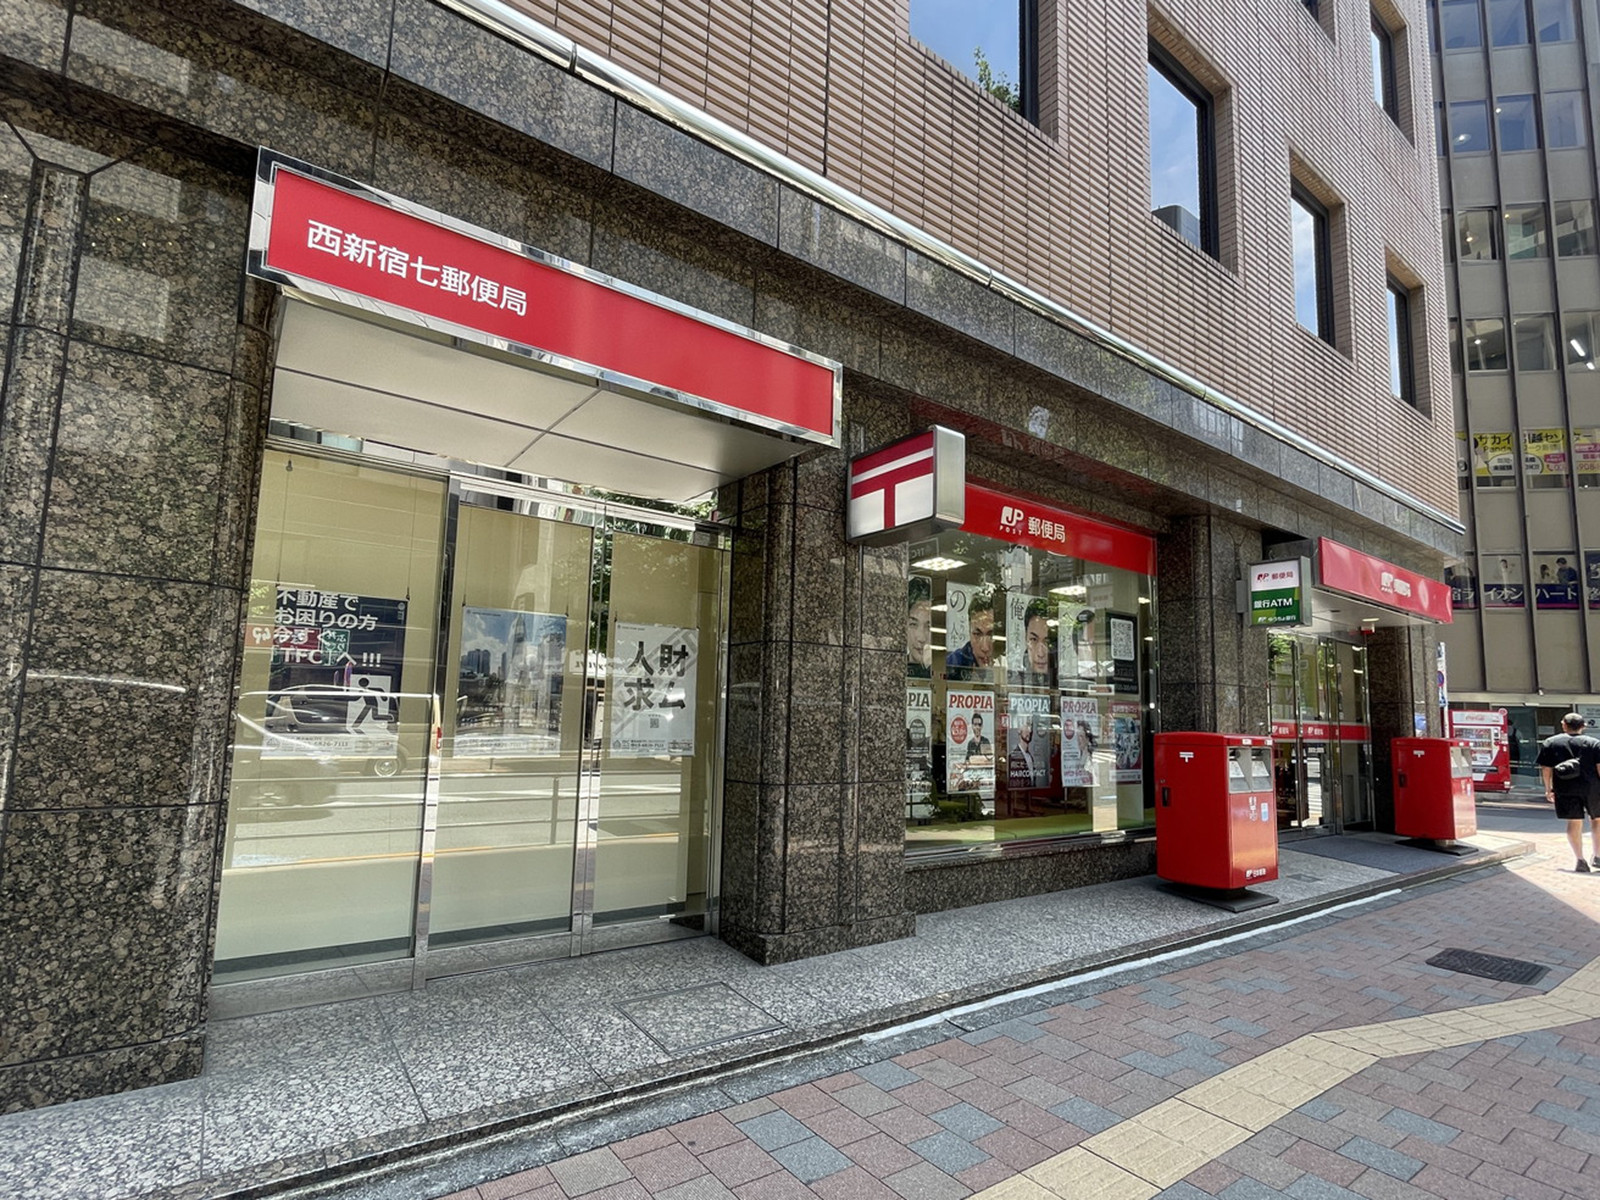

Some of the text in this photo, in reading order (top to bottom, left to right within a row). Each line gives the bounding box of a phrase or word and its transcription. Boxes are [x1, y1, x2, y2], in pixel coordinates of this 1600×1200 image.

[307, 219, 528, 317] 西新宿七郵便局
[999, 525, 1022, 536] POST
[1028, 516, 1066, 543] 郵便局
[276, 588, 359, 611] 不動産で
[1485, 588, 1523, 600] イオン
[1535, 588, 1577, 600] ハート
[1254, 598, 1293, 609] 銀行ATM
[275, 606, 379, 631] お困りの方
[625, 641, 689, 677] 人財
[908, 692, 930, 708] PIA
[949, 694, 993, 709] PROPIA
[1010, 697, 1049, 713] PROPIA
[1062, 700, 1097, 713] PROPIA
